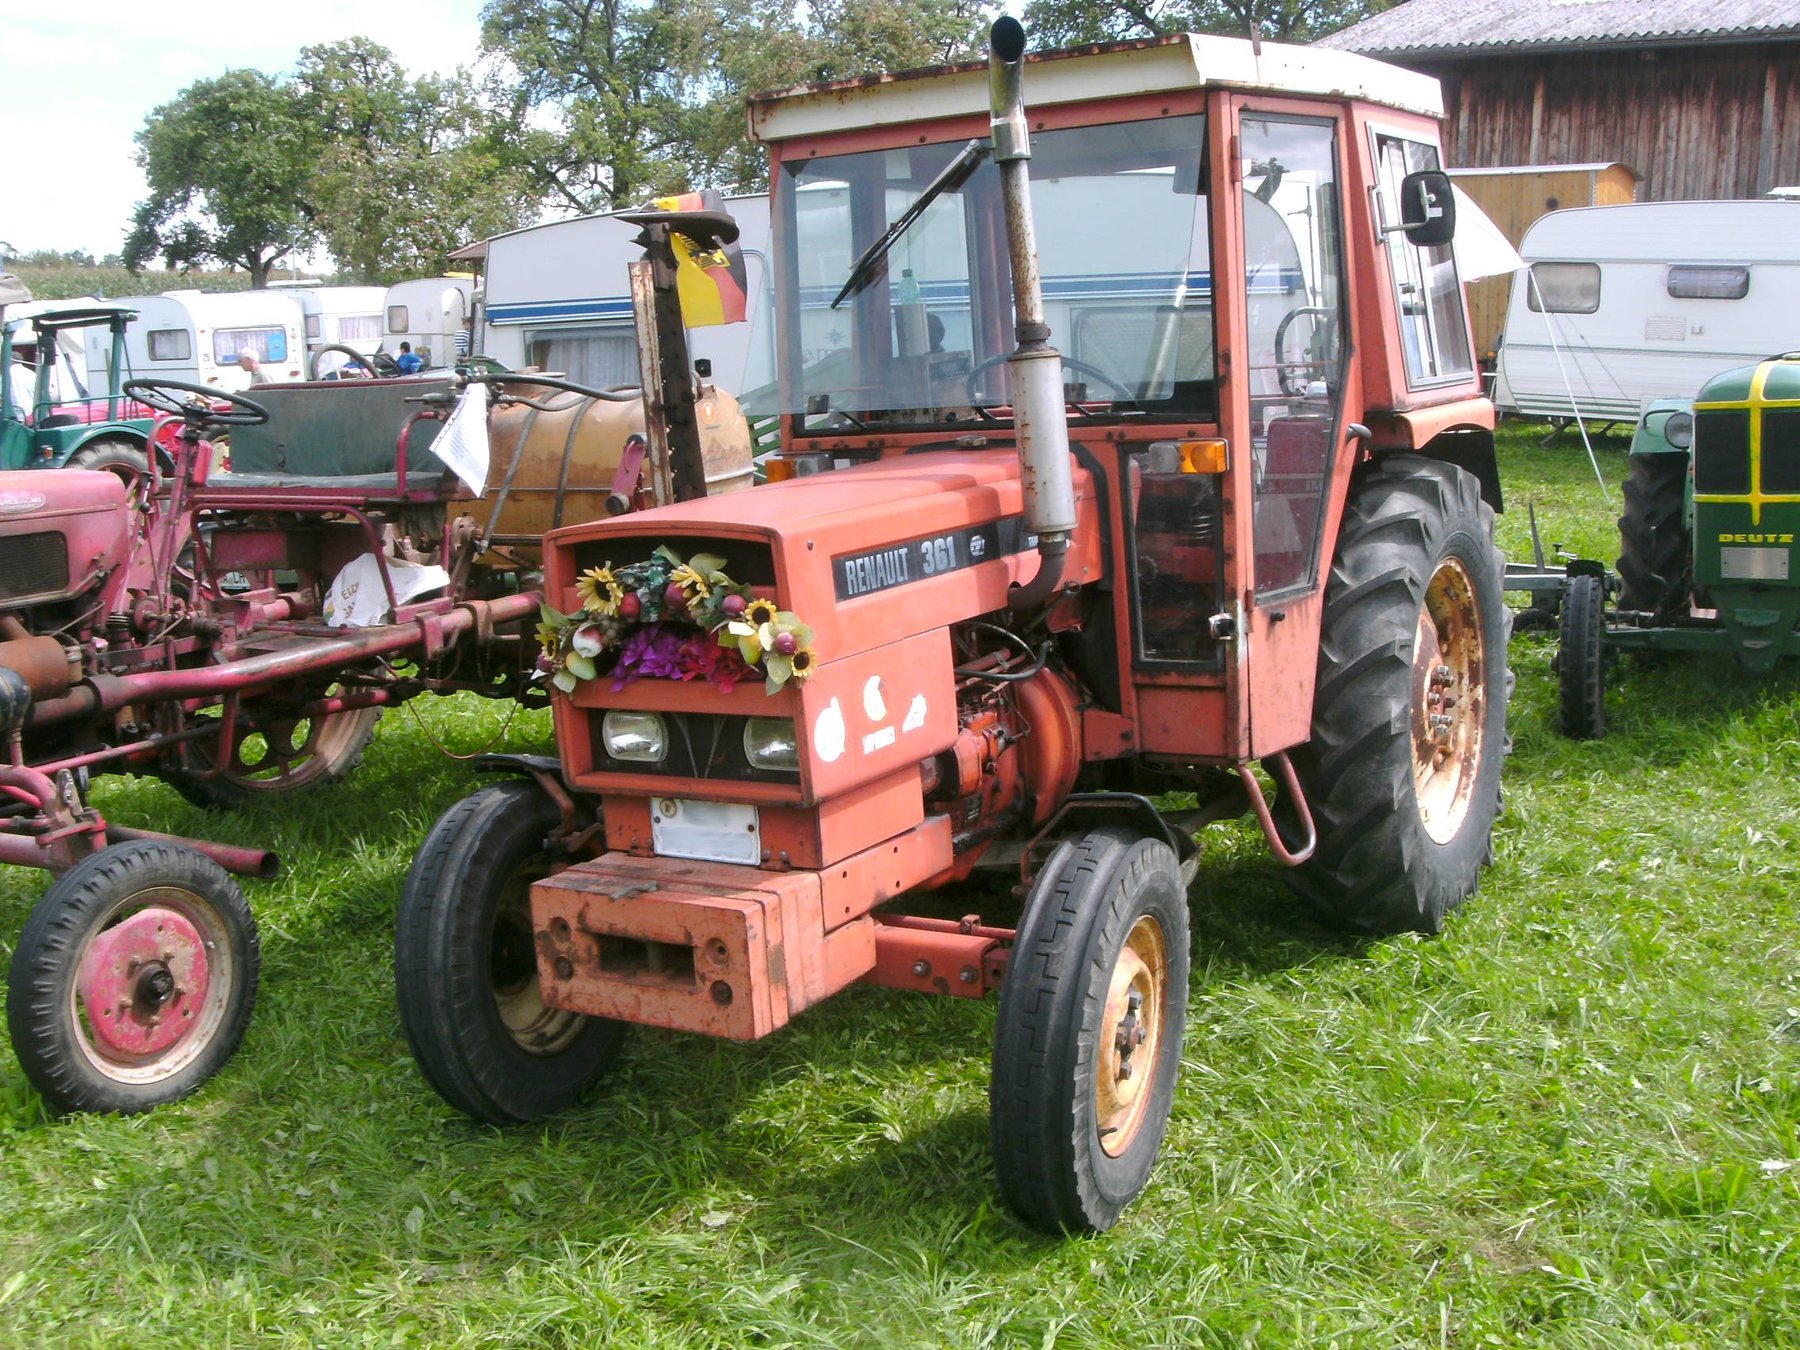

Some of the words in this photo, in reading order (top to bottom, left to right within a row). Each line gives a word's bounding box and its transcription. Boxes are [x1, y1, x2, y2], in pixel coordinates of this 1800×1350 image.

[1718, 533, 1794, 543] DEUTZ
[845, 547, 908, 595] RENAULT
[921, 535, 957, 574] 361
